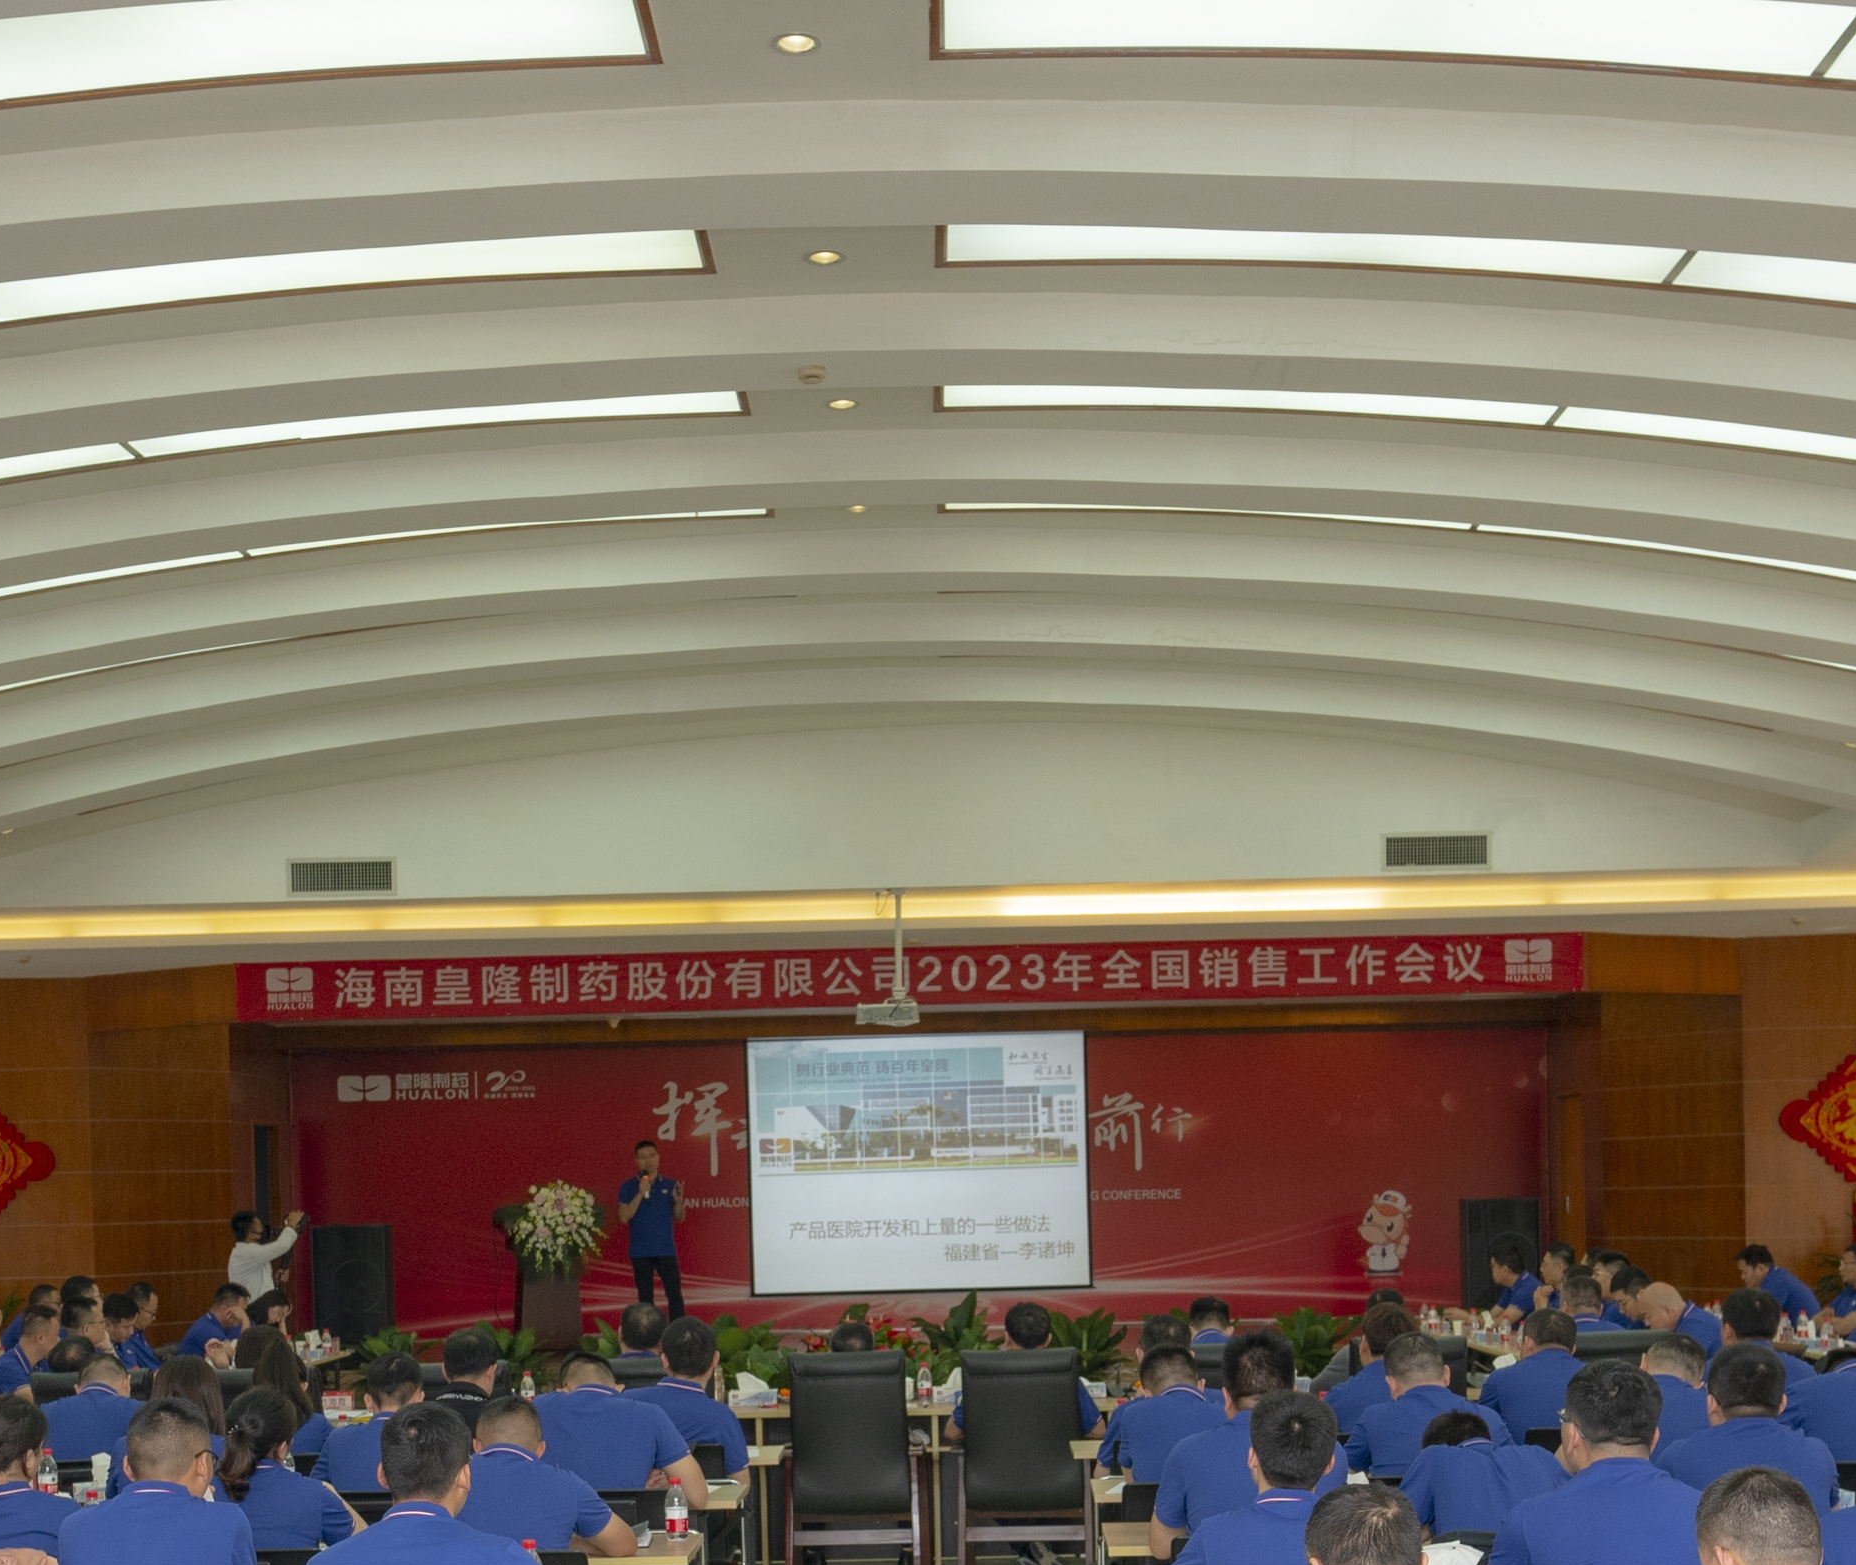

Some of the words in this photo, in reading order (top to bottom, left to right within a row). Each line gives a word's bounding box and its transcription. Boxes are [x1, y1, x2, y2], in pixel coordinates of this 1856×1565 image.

[333, 941, 1484, 1010] 海南皇隆制药股份有限公司2023年全国销售工作会议
[1505, 974, 1553, 983] HUALON
[267, 1002, 314, 1011] HUALON
[796, 1060, 870, 1077] 树行业典范
[876, 1058, 950, 1075] 铸百年皇隆
[395, 1088, 469, 1101] HUALON
[702, 1196, 750, 1208] HUALON
[1102, 1188, 1182, 1200] CONFERENCE
[788, 1213, 1051, 1240] 产品医院开发和上量的一些做法
